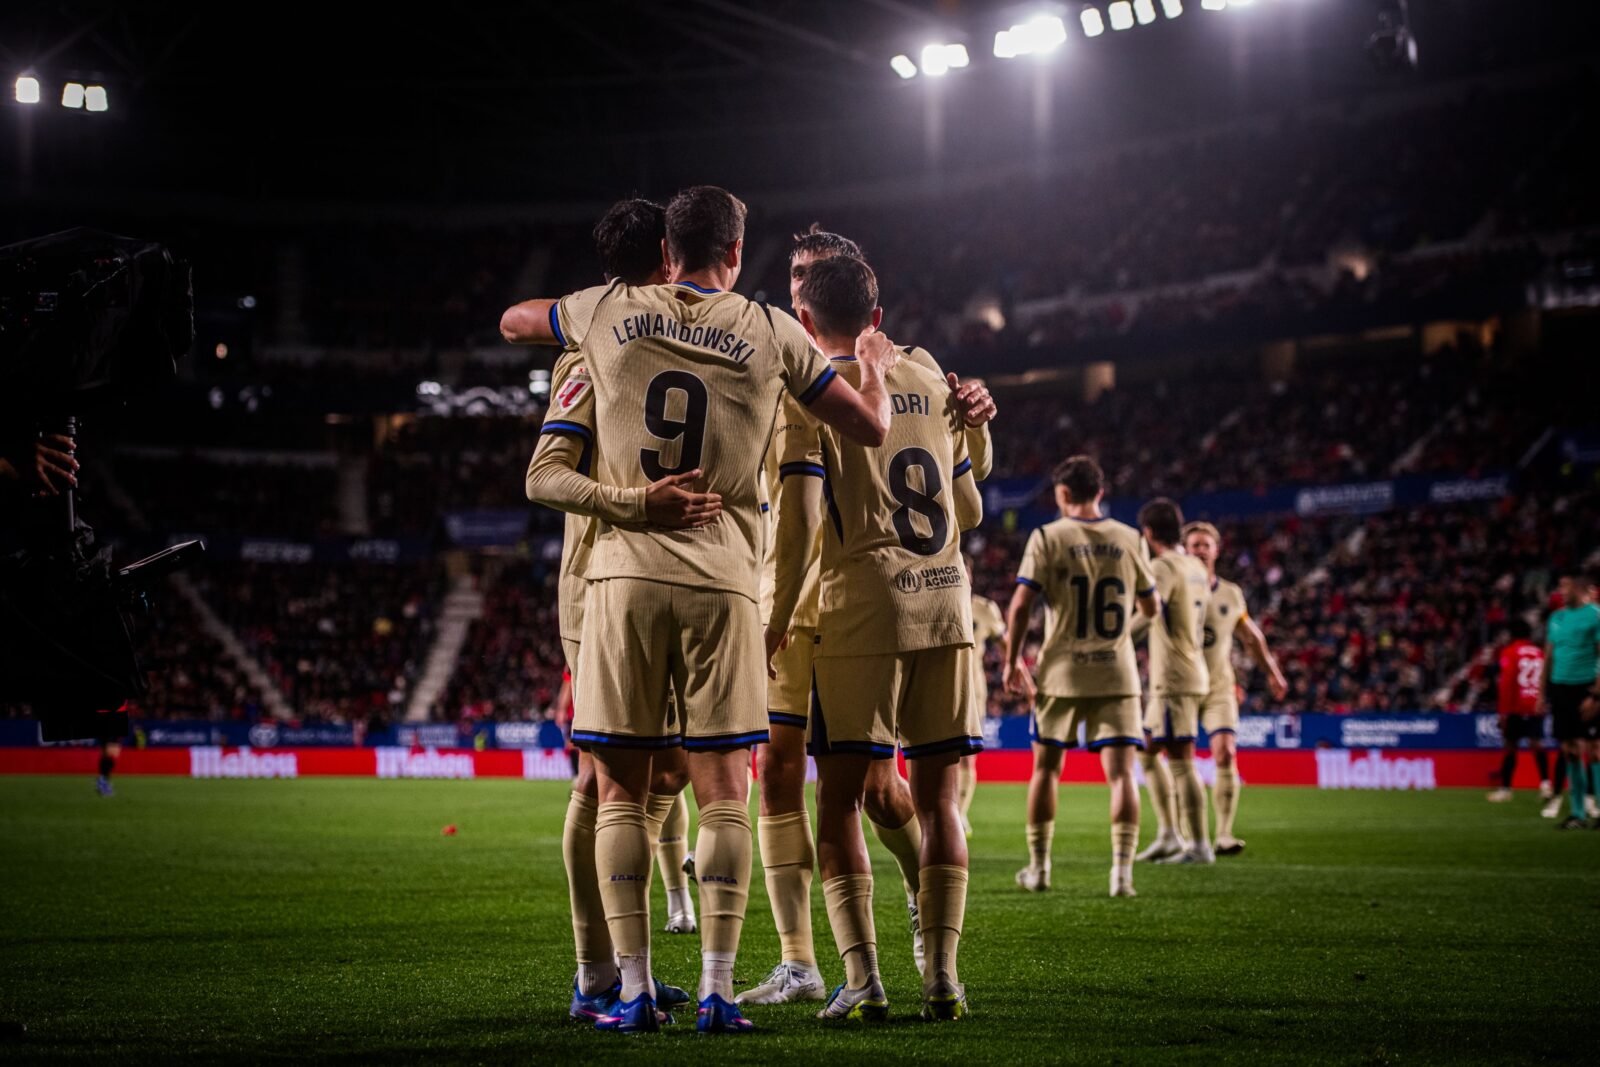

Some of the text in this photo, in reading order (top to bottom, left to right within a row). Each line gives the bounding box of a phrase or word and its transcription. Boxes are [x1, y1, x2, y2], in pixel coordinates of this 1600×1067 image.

[612, 312, 756, 365] LEWANDOWSKI
[639, 369, 709, 484] 9
[890, 393, 929, 416] DRI
[887, 446, 949, 557] 8
[920, 565, 960, 579] UNHCR
[1070, 576, 1125, 640] 16
[1315, 748, 1437, 790] Mahou
